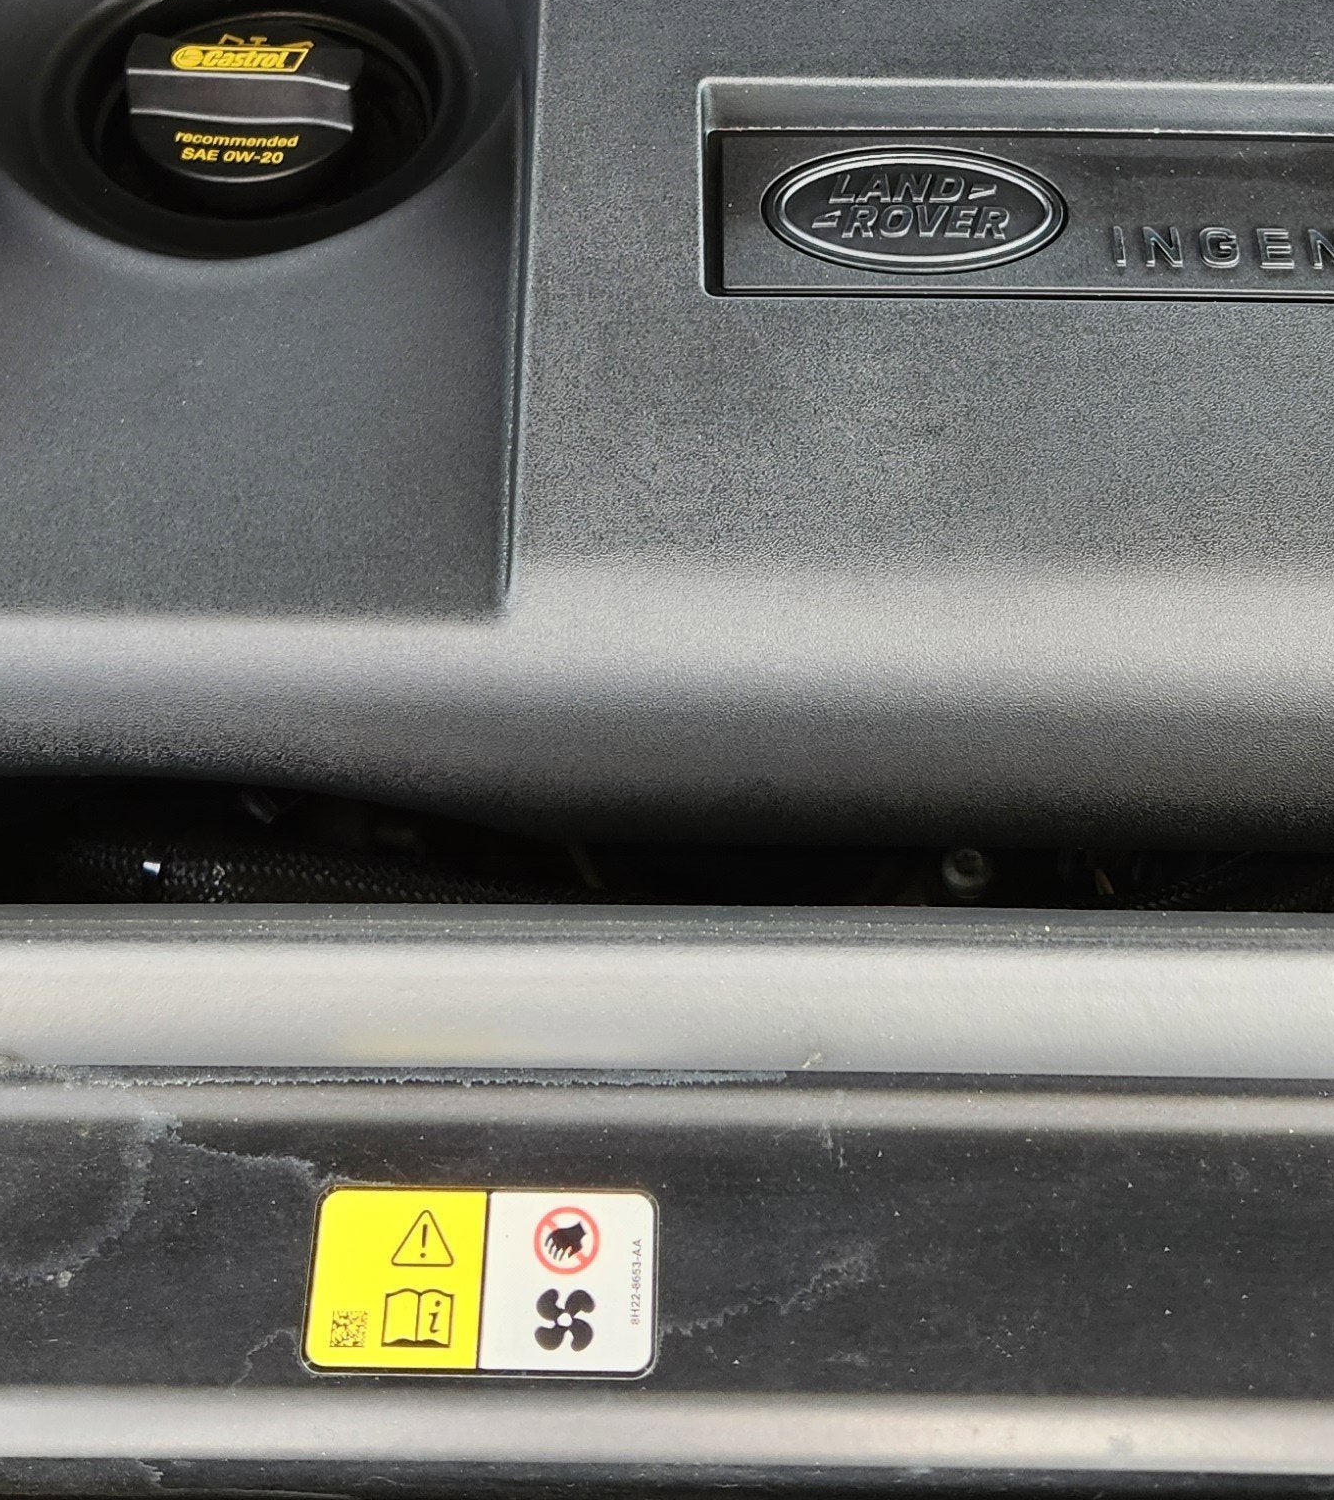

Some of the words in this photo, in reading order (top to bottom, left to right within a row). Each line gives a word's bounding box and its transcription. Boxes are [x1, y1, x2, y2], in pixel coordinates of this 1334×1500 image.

[201, 50, 287, 68] Castrol
[174, 131, 299, 148] recommended
[181, 148, 218, 162] SAE
[223, 151, 284, 165] 0W-20
[828, 173, 966, 204] LAND
[841, 204, 1010, 240] ROVER
